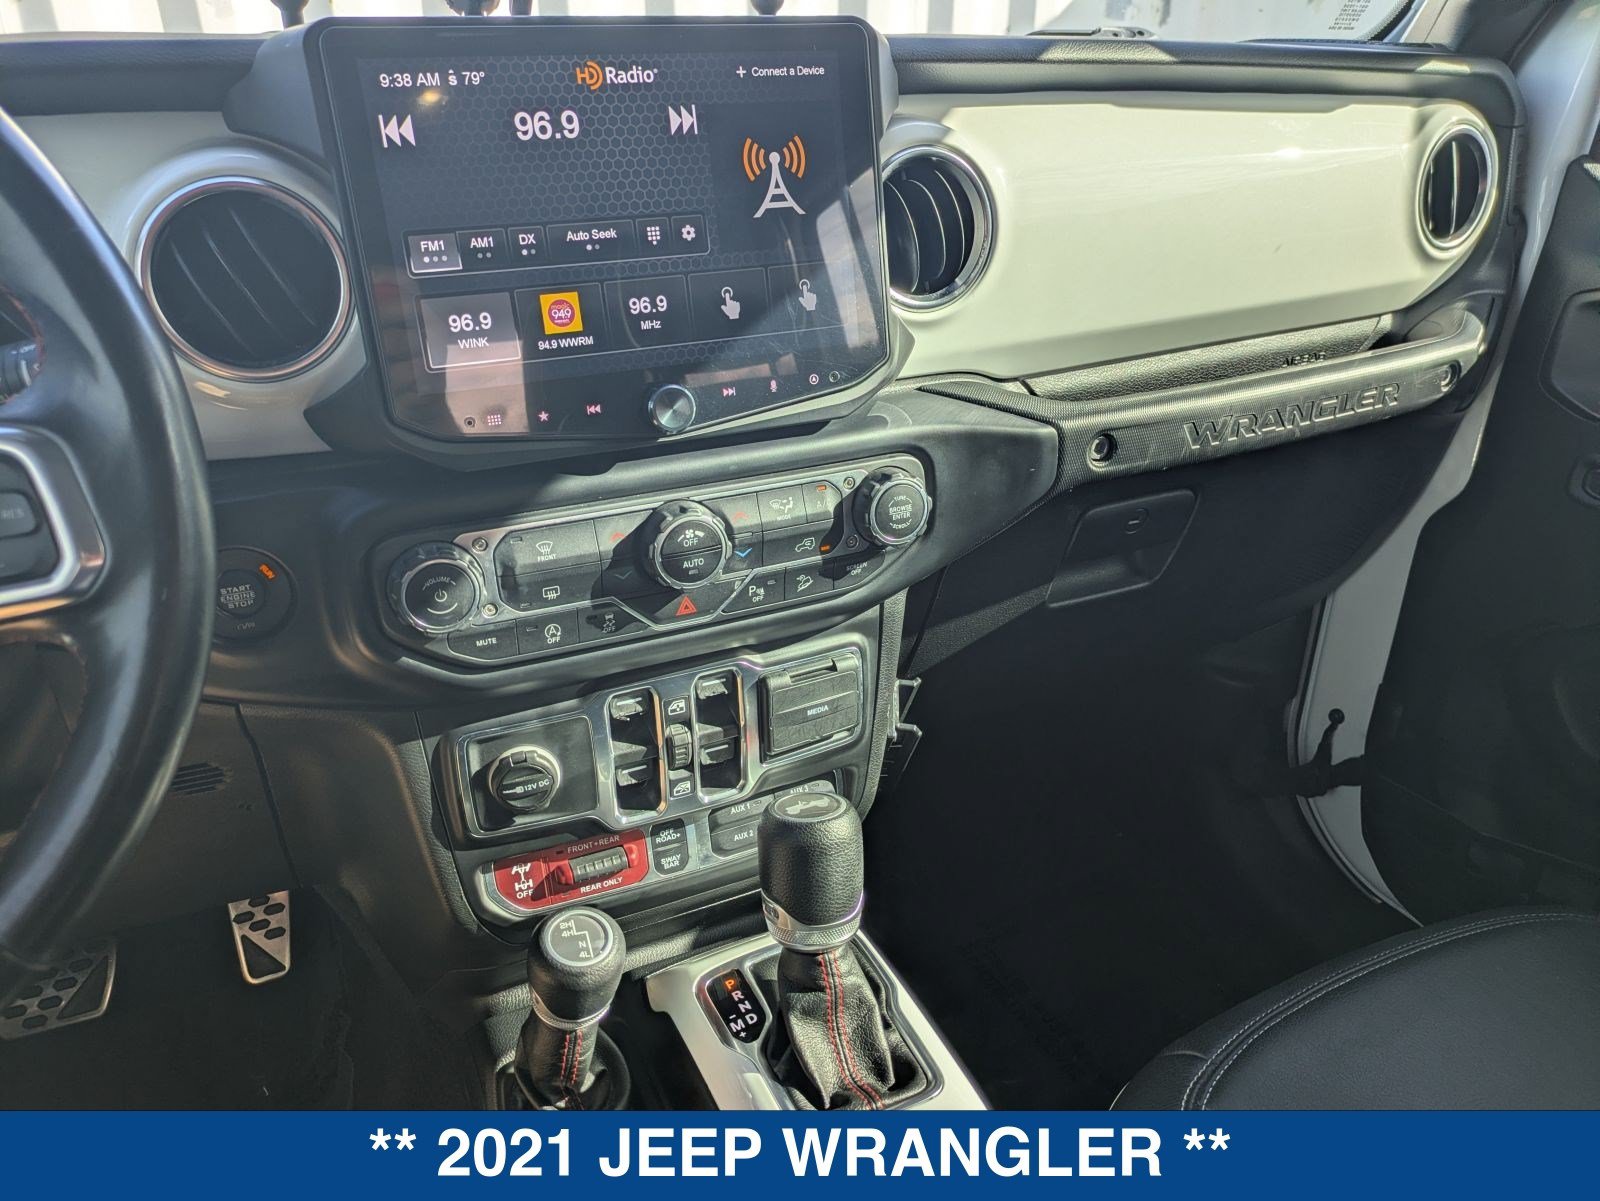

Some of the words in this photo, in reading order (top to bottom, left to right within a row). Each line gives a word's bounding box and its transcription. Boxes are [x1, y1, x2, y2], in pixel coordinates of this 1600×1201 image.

[605, 65, 655, 84] Radio
[751, 66, 787, 77] Connect
[797, 65, 825, 76] Device
[379, 73, 412, 87] 9:38
[416, 72, 441, 86] AM
[513, 110, 580, 141] 96.9
[518, 233, 536, 245] DX
[566, 230, 589, 242] Auto
[591, 228, 617, 240] Seek
[420, 240, 445, 252] FM1
[470, 237, 494, 249] AM1
[628, 295, 667, 315] 96.9
[448, 312, 492, 333] 96.9
[640, 320, 661, 330] MHz
[457, 337, 490, 349] WINK
[538, 339, 558, 351] 94.9
[558, 335, 594, 347] WWRM
[1184, 382, 1400, 449] WRANGLER
[889, 504, 912, 514] BROWSE
[892, 511, 911, 520] ENTER
[683, 537, 699, 547] OFF
[537, 554, 556, 562] FRONT
[682, 558, 704, 569] AUTO
[220, 584, 251, 595] START
[220, 591, 256, 603] ENGINE
[227, 600, 254, 609] STOP
[475, 637, 497, 648] MUTE
[547, 635, 561, 644] OFF
[807, 704, 829, 716] MEDIA
[524, 782, 537, 792] 12V
[538, 778, 550, 788] DC
[730, 804, 746, 814] AUX
[660, 828, 674, 838] OFF
[733, 832, 748, 842] AUX
[660, 853, 681, 865] SWAY
[580, 882, 601, 894] REAR
[603, 876, 623, 888] ONLY
[516, 889, 534, 899] OFF
[559, 921, 573, 930] 2H
[561, 928, 574, 937] 4H
[578, 940, 586, 948] N
[578, 950, 590, 958] 4L
[725, 979, 735, 990] P
[731, 990, 744, 1001] R
[738, 1000, 752, 1013] N
[745, 1013, 758, 1025] D
[729, 1018, 746, 1033] M
